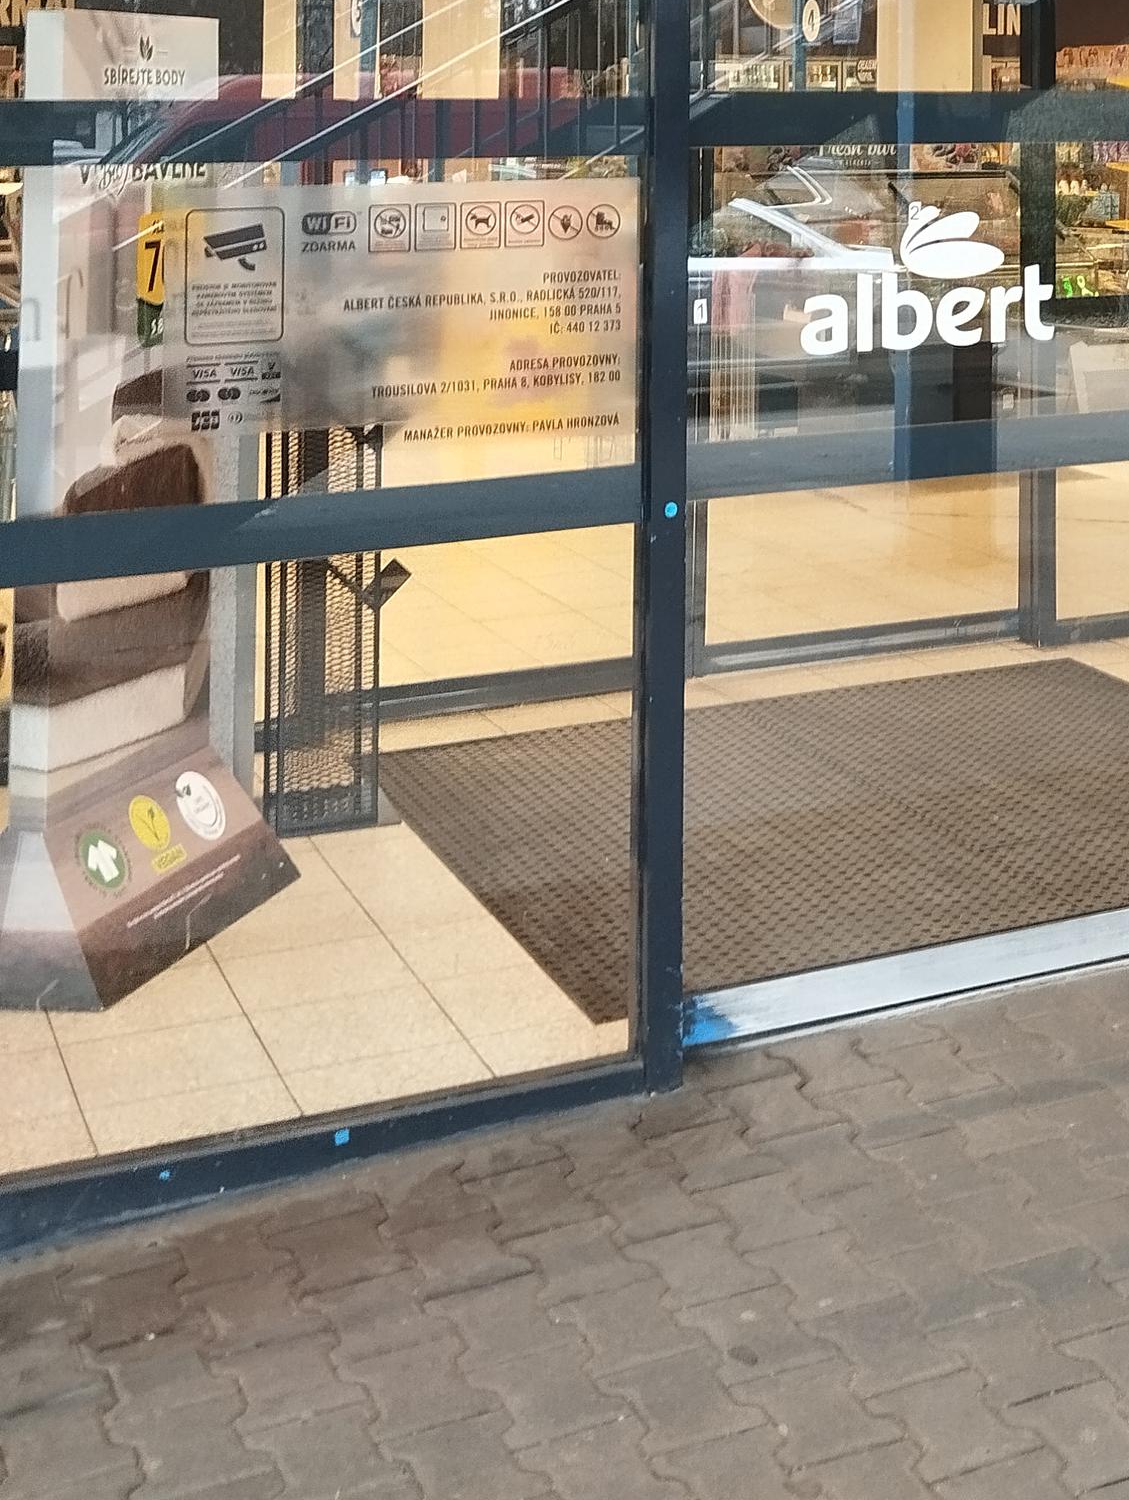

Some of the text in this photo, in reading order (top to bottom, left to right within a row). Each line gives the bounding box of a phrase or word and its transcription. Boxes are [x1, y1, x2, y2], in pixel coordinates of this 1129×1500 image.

[807, 9, 816, 30] 4
[983, 3, 1021, 36] LIN
[155, 68, 187, 86] BODY
[302, 240, 356, 253] ZDARMA
[543, 269, 622, 285] PROVOZOVATEL:
[343, 297, 385, 312] ALBERT
[388, 294, 421, 310] ČESKÁ
[425, 291, 487, 307] REPUBLIKA,
[526, 286, 576, 302] RADLICKÁ
[578, 285, 622, 300] 520/117,
[489, 303, 622, 322] JINONICE, 158 00 PRAHA 5
[800, 263, 1055, 356] albert
[566, 320, 586, 334] 440
[588, 320, 602, 333] 12
[603, 319, 622, 332] 373
[230, 365, 255, 377] VISA
[509, 353, 621, 372] ADRESA PROVOZOVNY:
[193, 368, 217, 380] VISA
[483, 377, 518, 391] PRAHA
[533, 372, 585, 388] KOBYLISY,
[587, 371, 606, 384] 182
[608, 370, 621, 383] 00
[403, 411, 620, 443] MANAŽER PROVOZOVNY: PAVLA HRONZOVÁ
